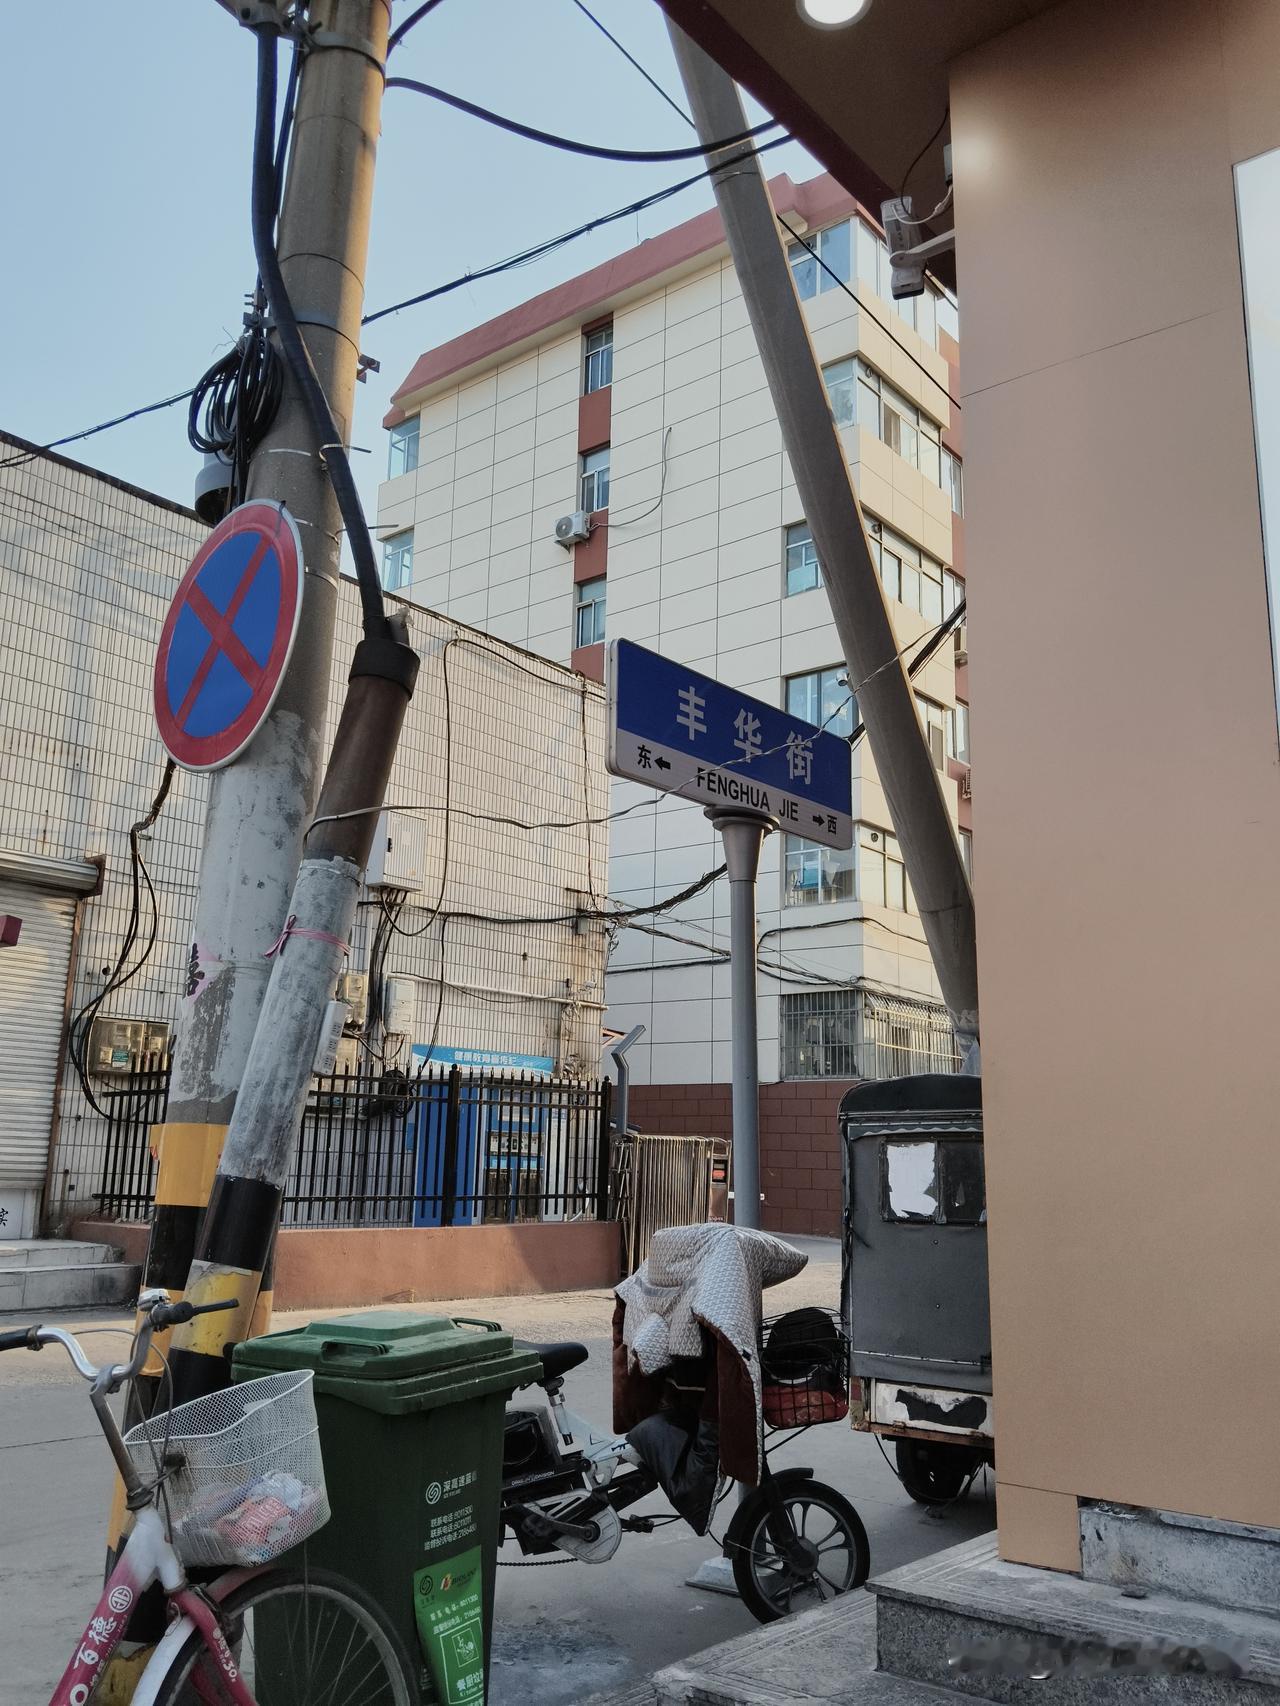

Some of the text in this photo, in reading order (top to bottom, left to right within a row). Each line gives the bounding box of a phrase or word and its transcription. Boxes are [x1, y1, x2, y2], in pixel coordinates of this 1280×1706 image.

[676, 685, 813, 785] 丰华街
[637, 744, 652, 769] 东
[696, 766, 799, 822] FENGHUA JIE
[827, 814, 838, 835] 西
